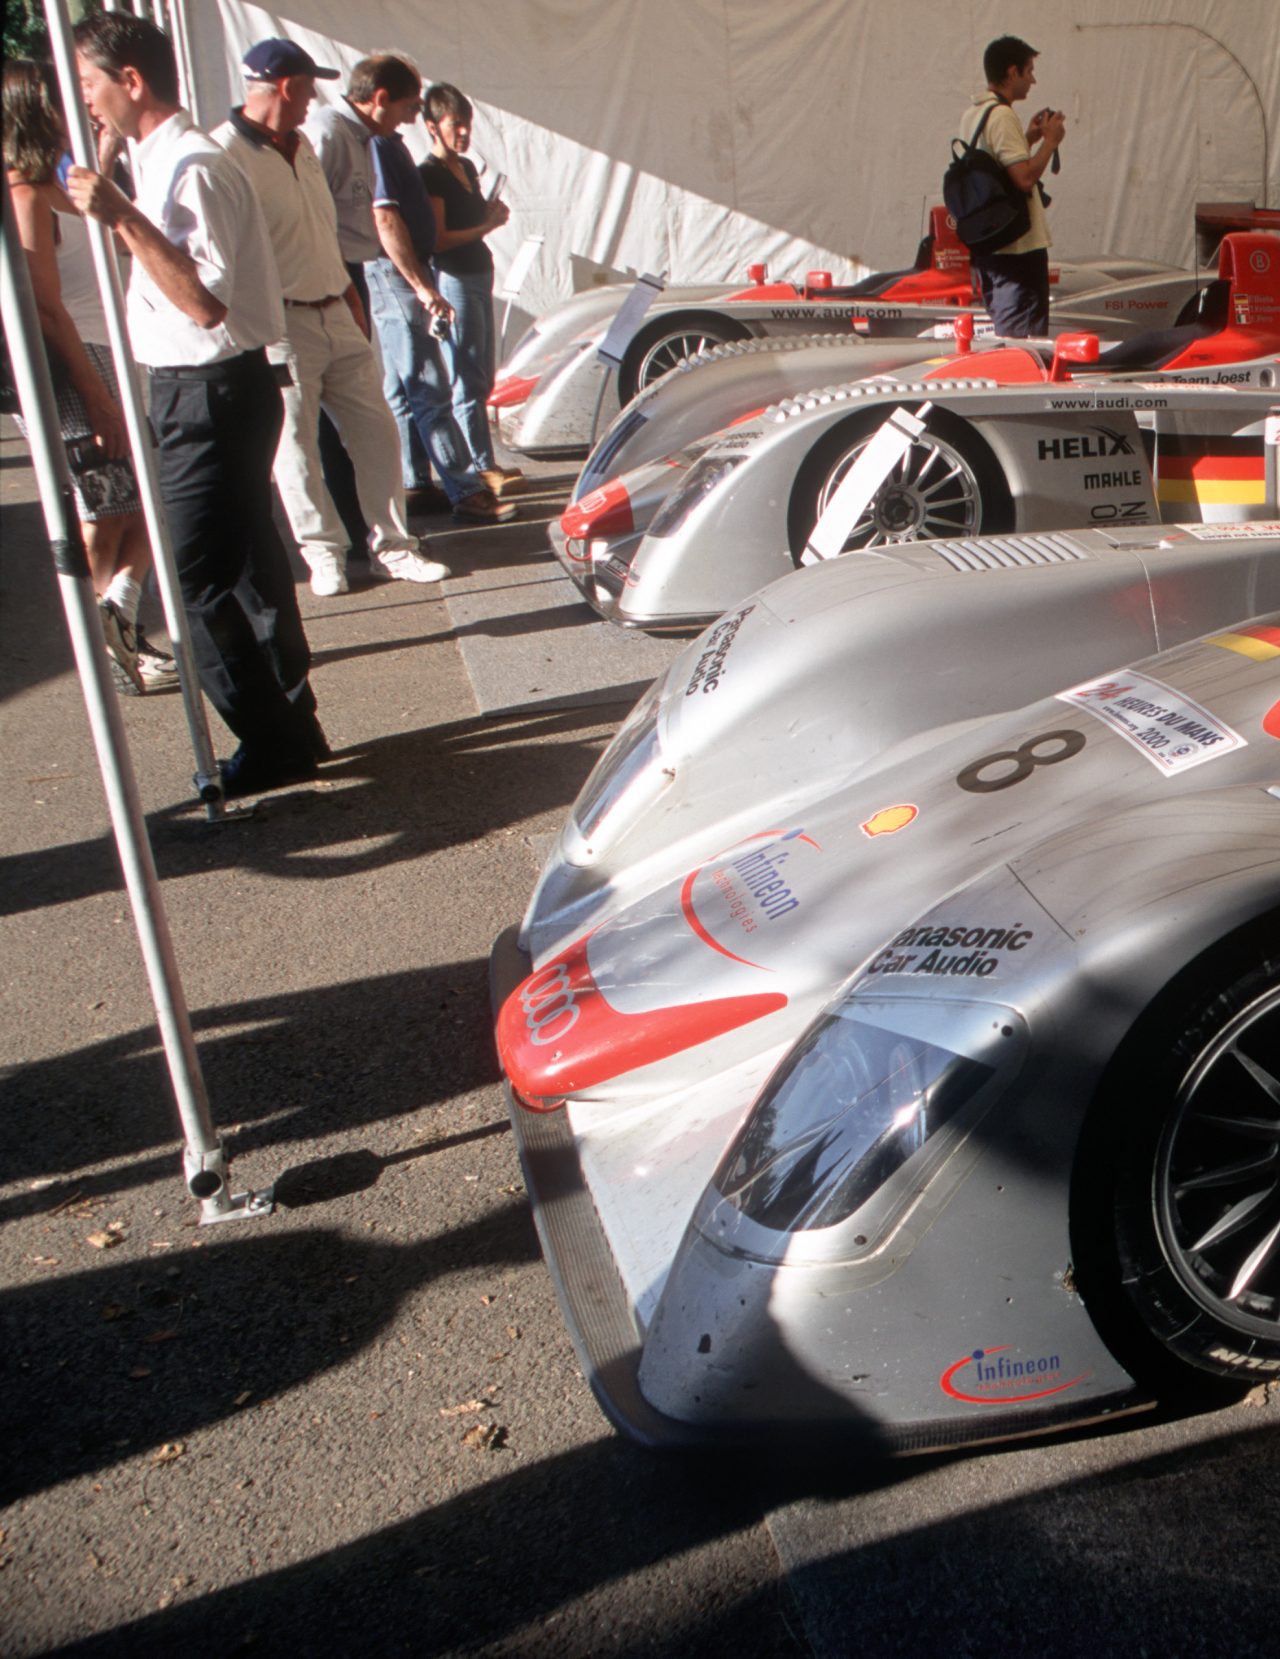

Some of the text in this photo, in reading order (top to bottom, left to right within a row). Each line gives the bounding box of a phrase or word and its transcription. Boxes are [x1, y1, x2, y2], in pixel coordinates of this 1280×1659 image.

[770, 306, 903, 319] www.audi.com
[1104, 299, 1169, 310] FSI Power
[1212, 370, 1251, 385] Joest
[1050, 397, 1168, 410] www.audi.com
[1037, 437, 1136, 461] HELIX
[1084, 470, 1142, 490] MAHLE
[685, 621, 731, 697] Car Audio
[703, 604, 757, 694] Panasonic
[1075, 682, 1225, 746] 24 HEURES DU MANS
[1136, 728, 1171, 749] 2000
[956, 729, 1087, 794] 8
[732, 843, 800, 921] Infineon
[711, 868, 758, 934] technologies
[891, 922, 1034, 951] anasonic
[867, 949, 999, 976] Car Audio
[976, 1355, 1061, 1381] Infineon
